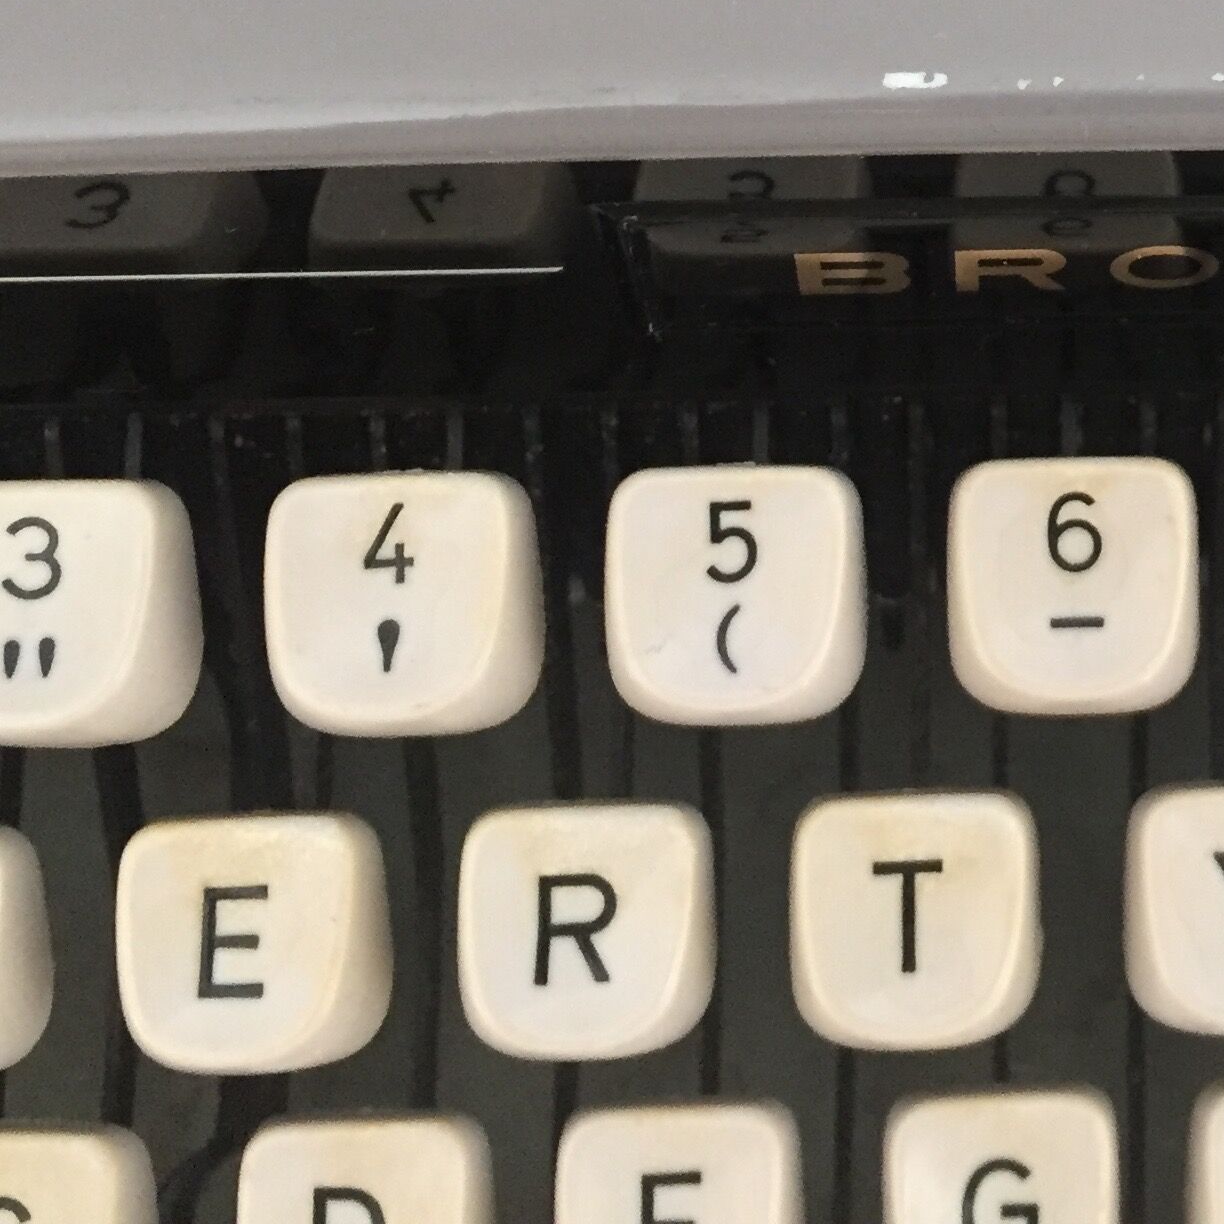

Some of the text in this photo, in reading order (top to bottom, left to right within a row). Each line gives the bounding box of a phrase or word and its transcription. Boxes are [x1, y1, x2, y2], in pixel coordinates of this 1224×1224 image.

[0, 516, 63, 601] 3
[363, 502, 415, 585] 4
[706, 499, 758, 584] 5
[1047, 491, 1103, 573] 6
[716, 604, 741, 674] (
[197, 884, 269, 1000] E
[533, 872, 618, 987] R
[872, 859, 944, 974] T
[961, 1157, 1040, 1224] G
